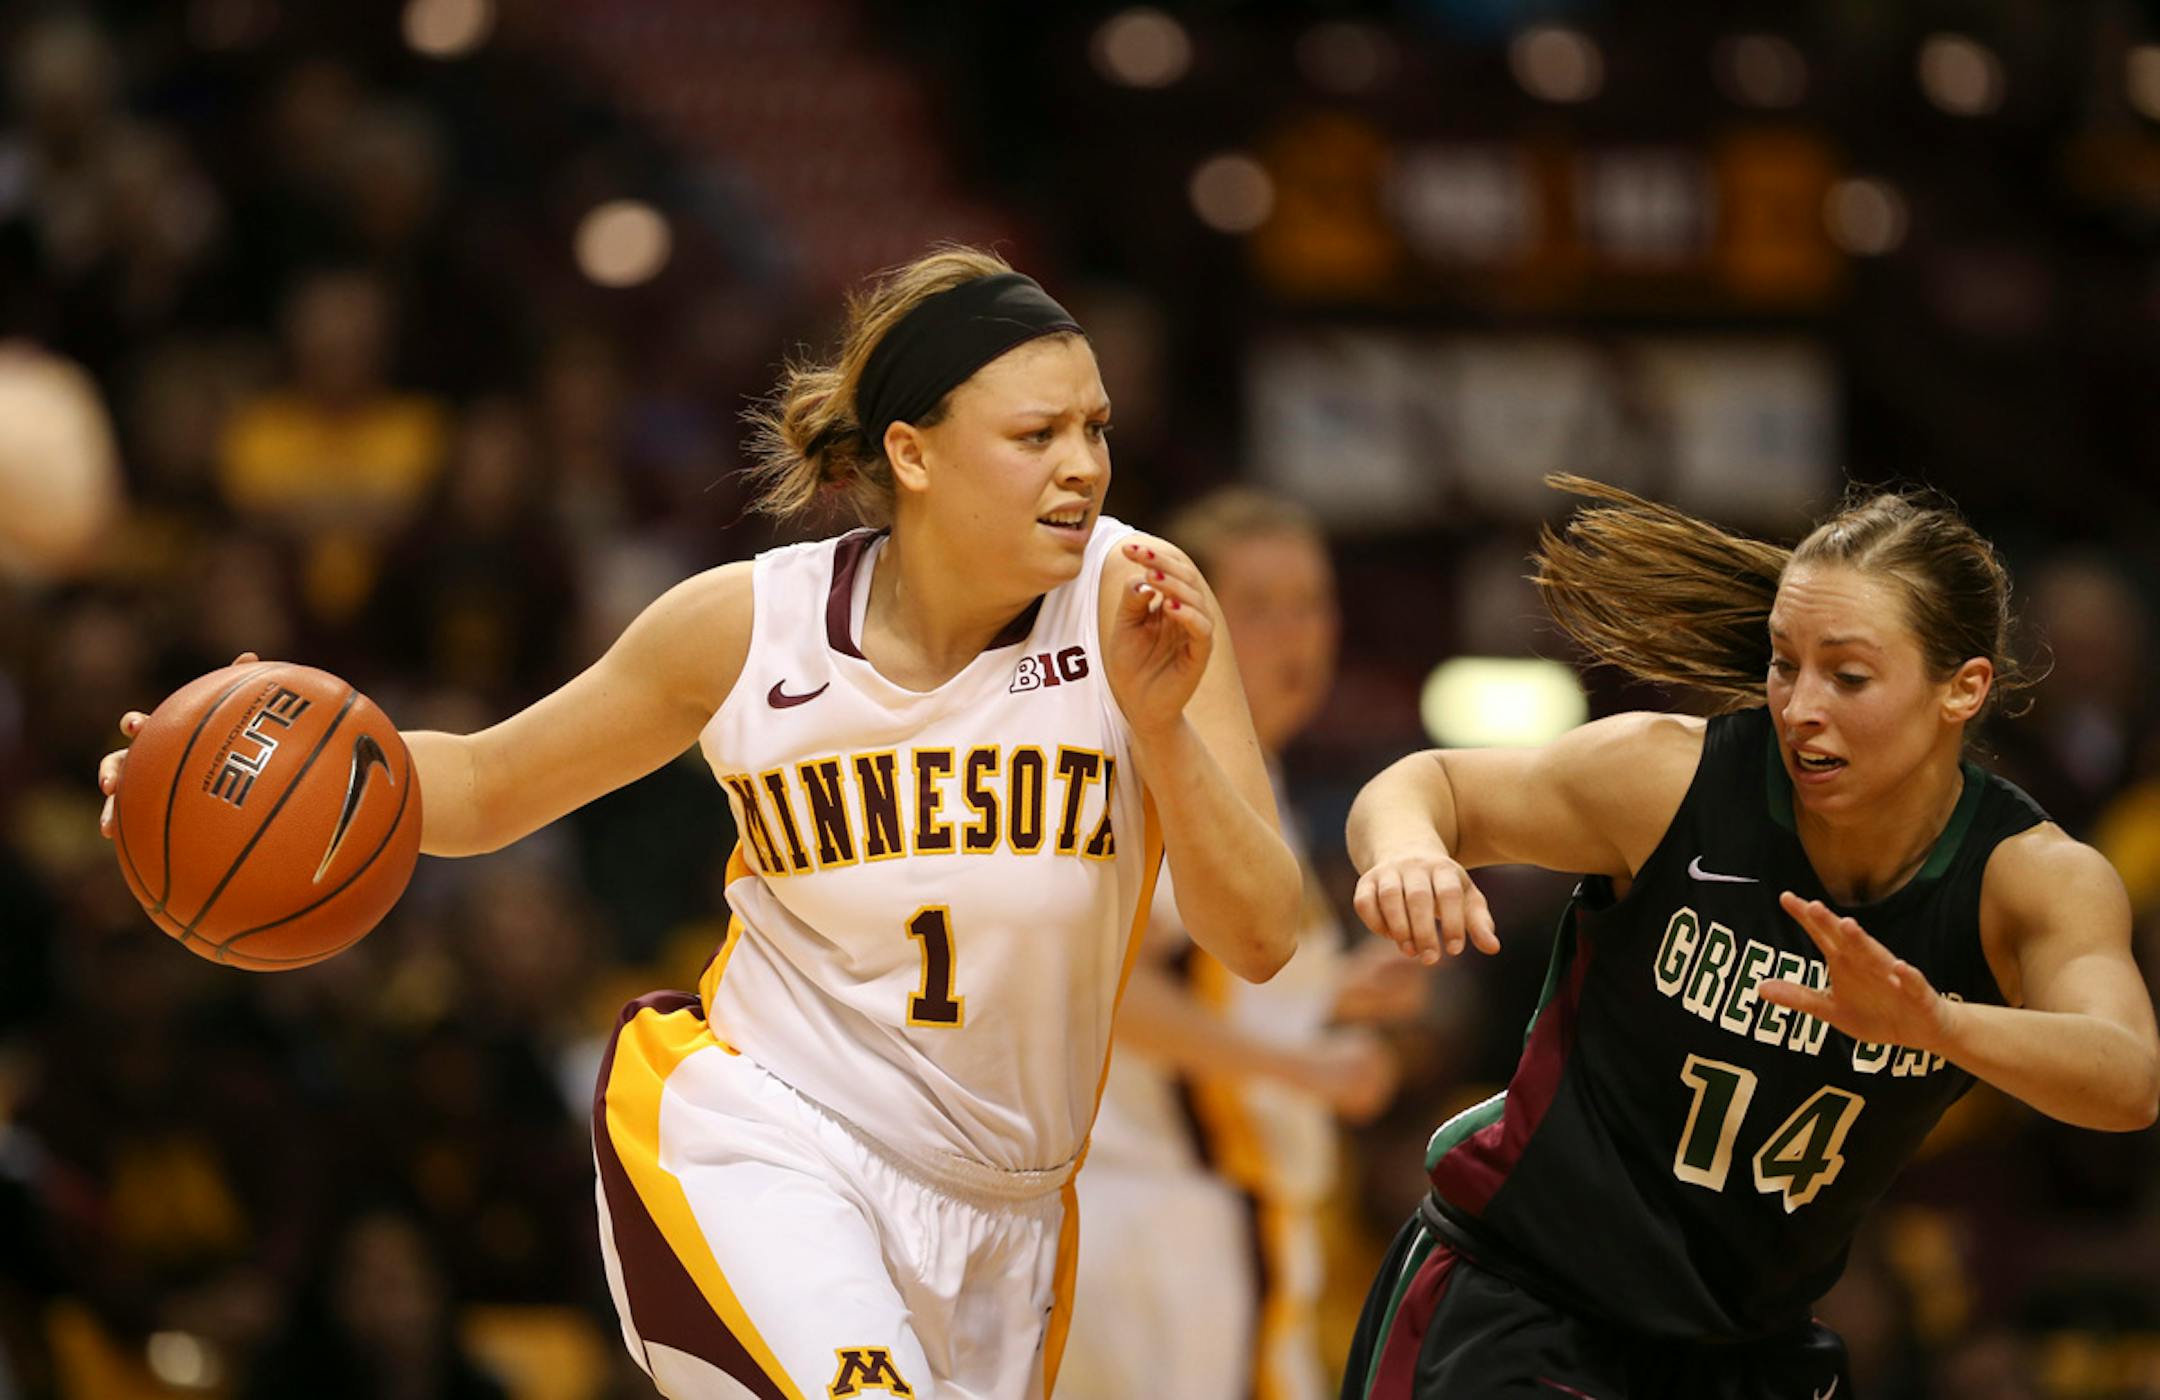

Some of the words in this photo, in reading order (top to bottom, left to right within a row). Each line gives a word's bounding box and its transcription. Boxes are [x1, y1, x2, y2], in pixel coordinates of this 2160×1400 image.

[207, 687, 311, 809] ELITE
[723, 744, 1116, 877] MINNESOTA
[905, 904, 965, 1028] 1
[1673, 1053, 1866, 1214] 14
[827, 1346, 915, 1400] M
